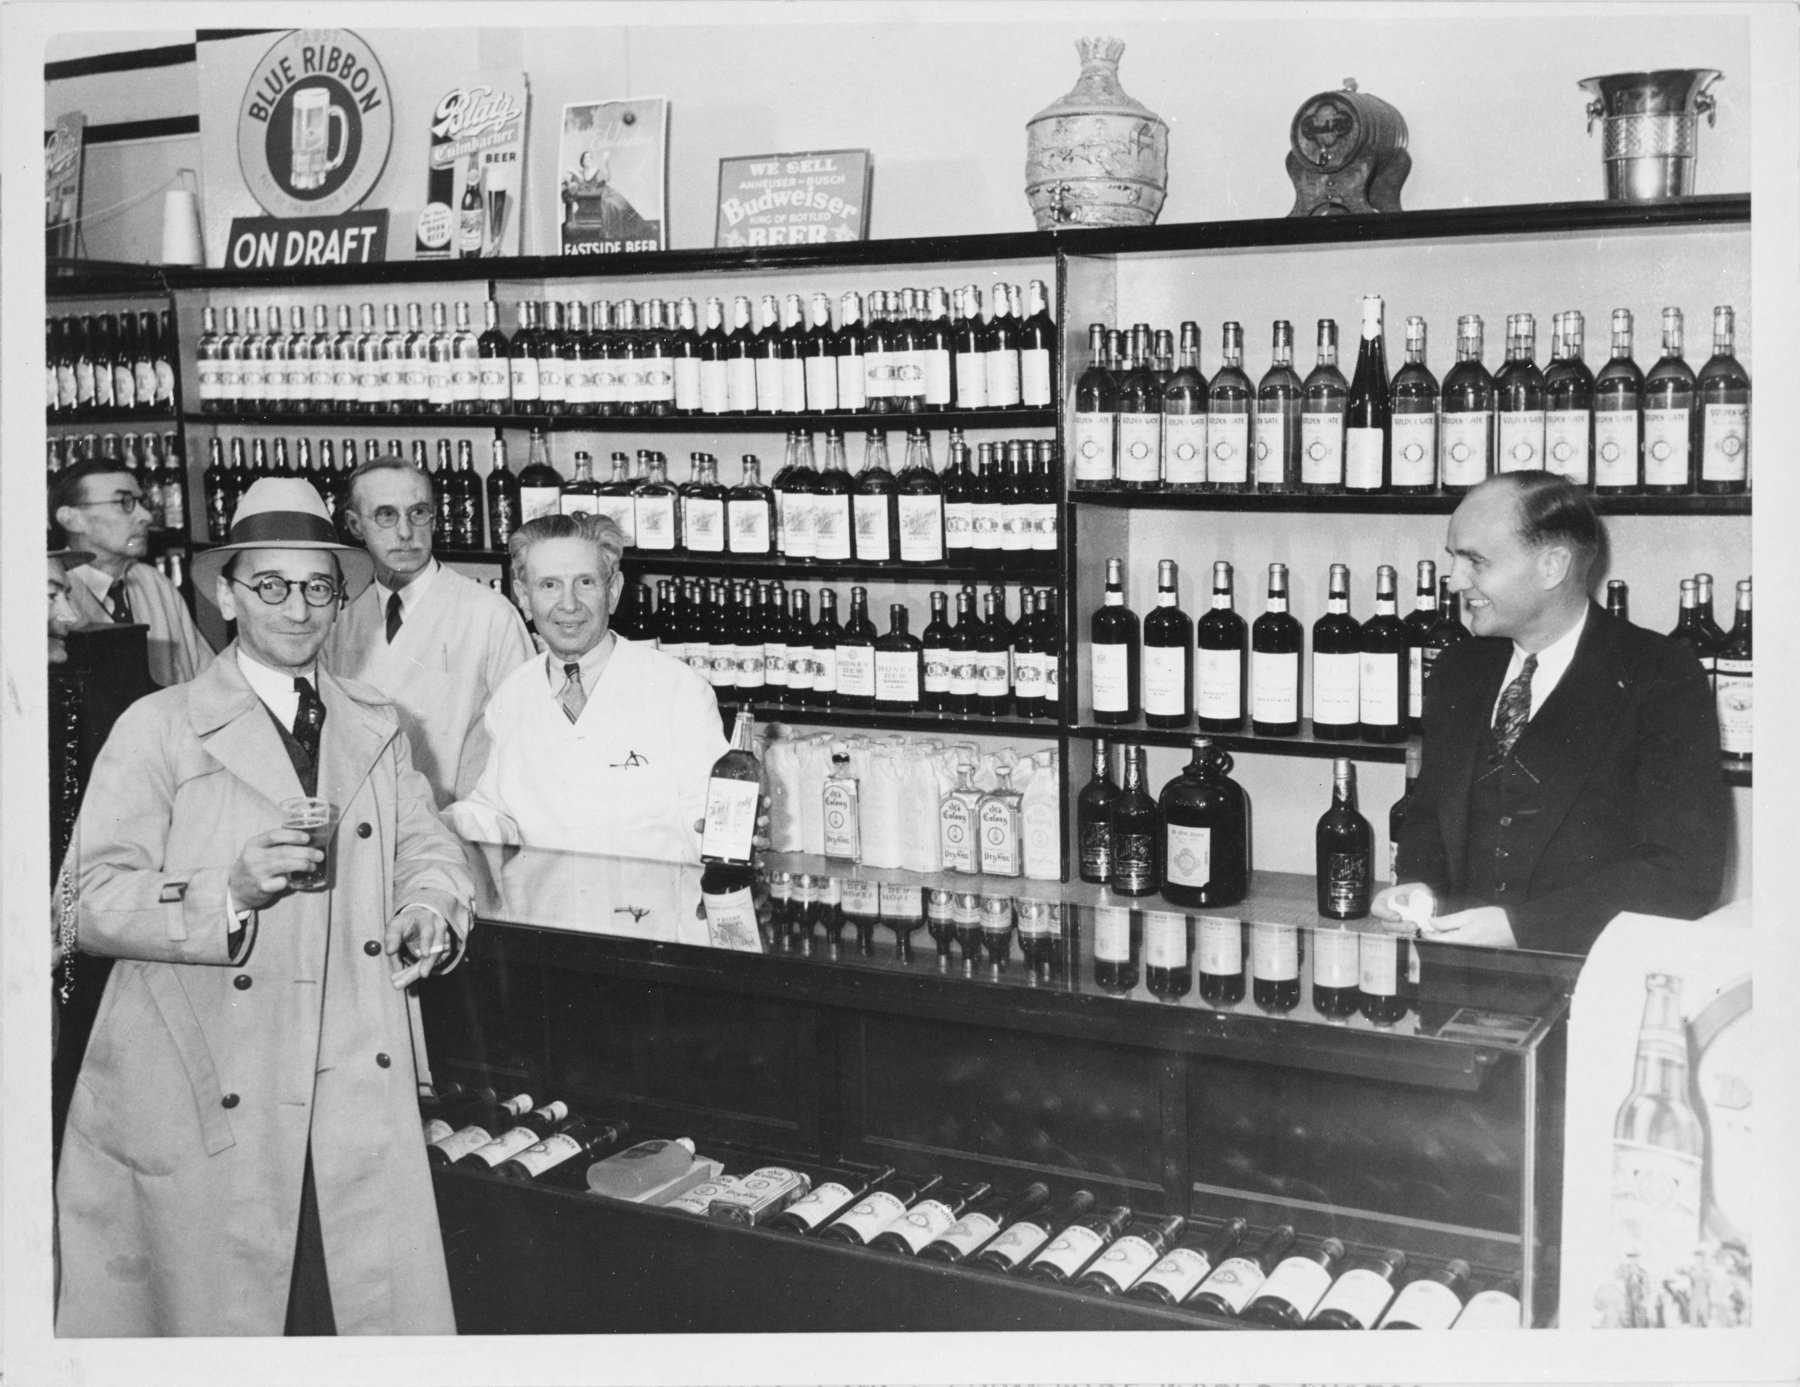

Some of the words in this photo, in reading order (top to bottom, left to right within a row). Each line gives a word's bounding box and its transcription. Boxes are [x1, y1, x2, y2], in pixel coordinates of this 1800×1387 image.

[248, 56, 296, 122] BLUE
[302, 45, 382, 114] RIBBON
[485, 152, 517, 164] BEER
[750, 162, 779, 176] WE
[786, 158, 837, 174] SELL
[721, 186, 858, 226] Budweiser
[750, 215, 772, 224] KING
[774, 214, 787, 223] OF
[789, 212, 831, 223] BOTTLED
[748, 224, 828, 247] BEER
[233, 231, 279, 267] ON
[284, 226, 377, 265] DRAFT
[564, 241, 621, 256] EASTSIDE
[625, 239, 657, 253] BEER
